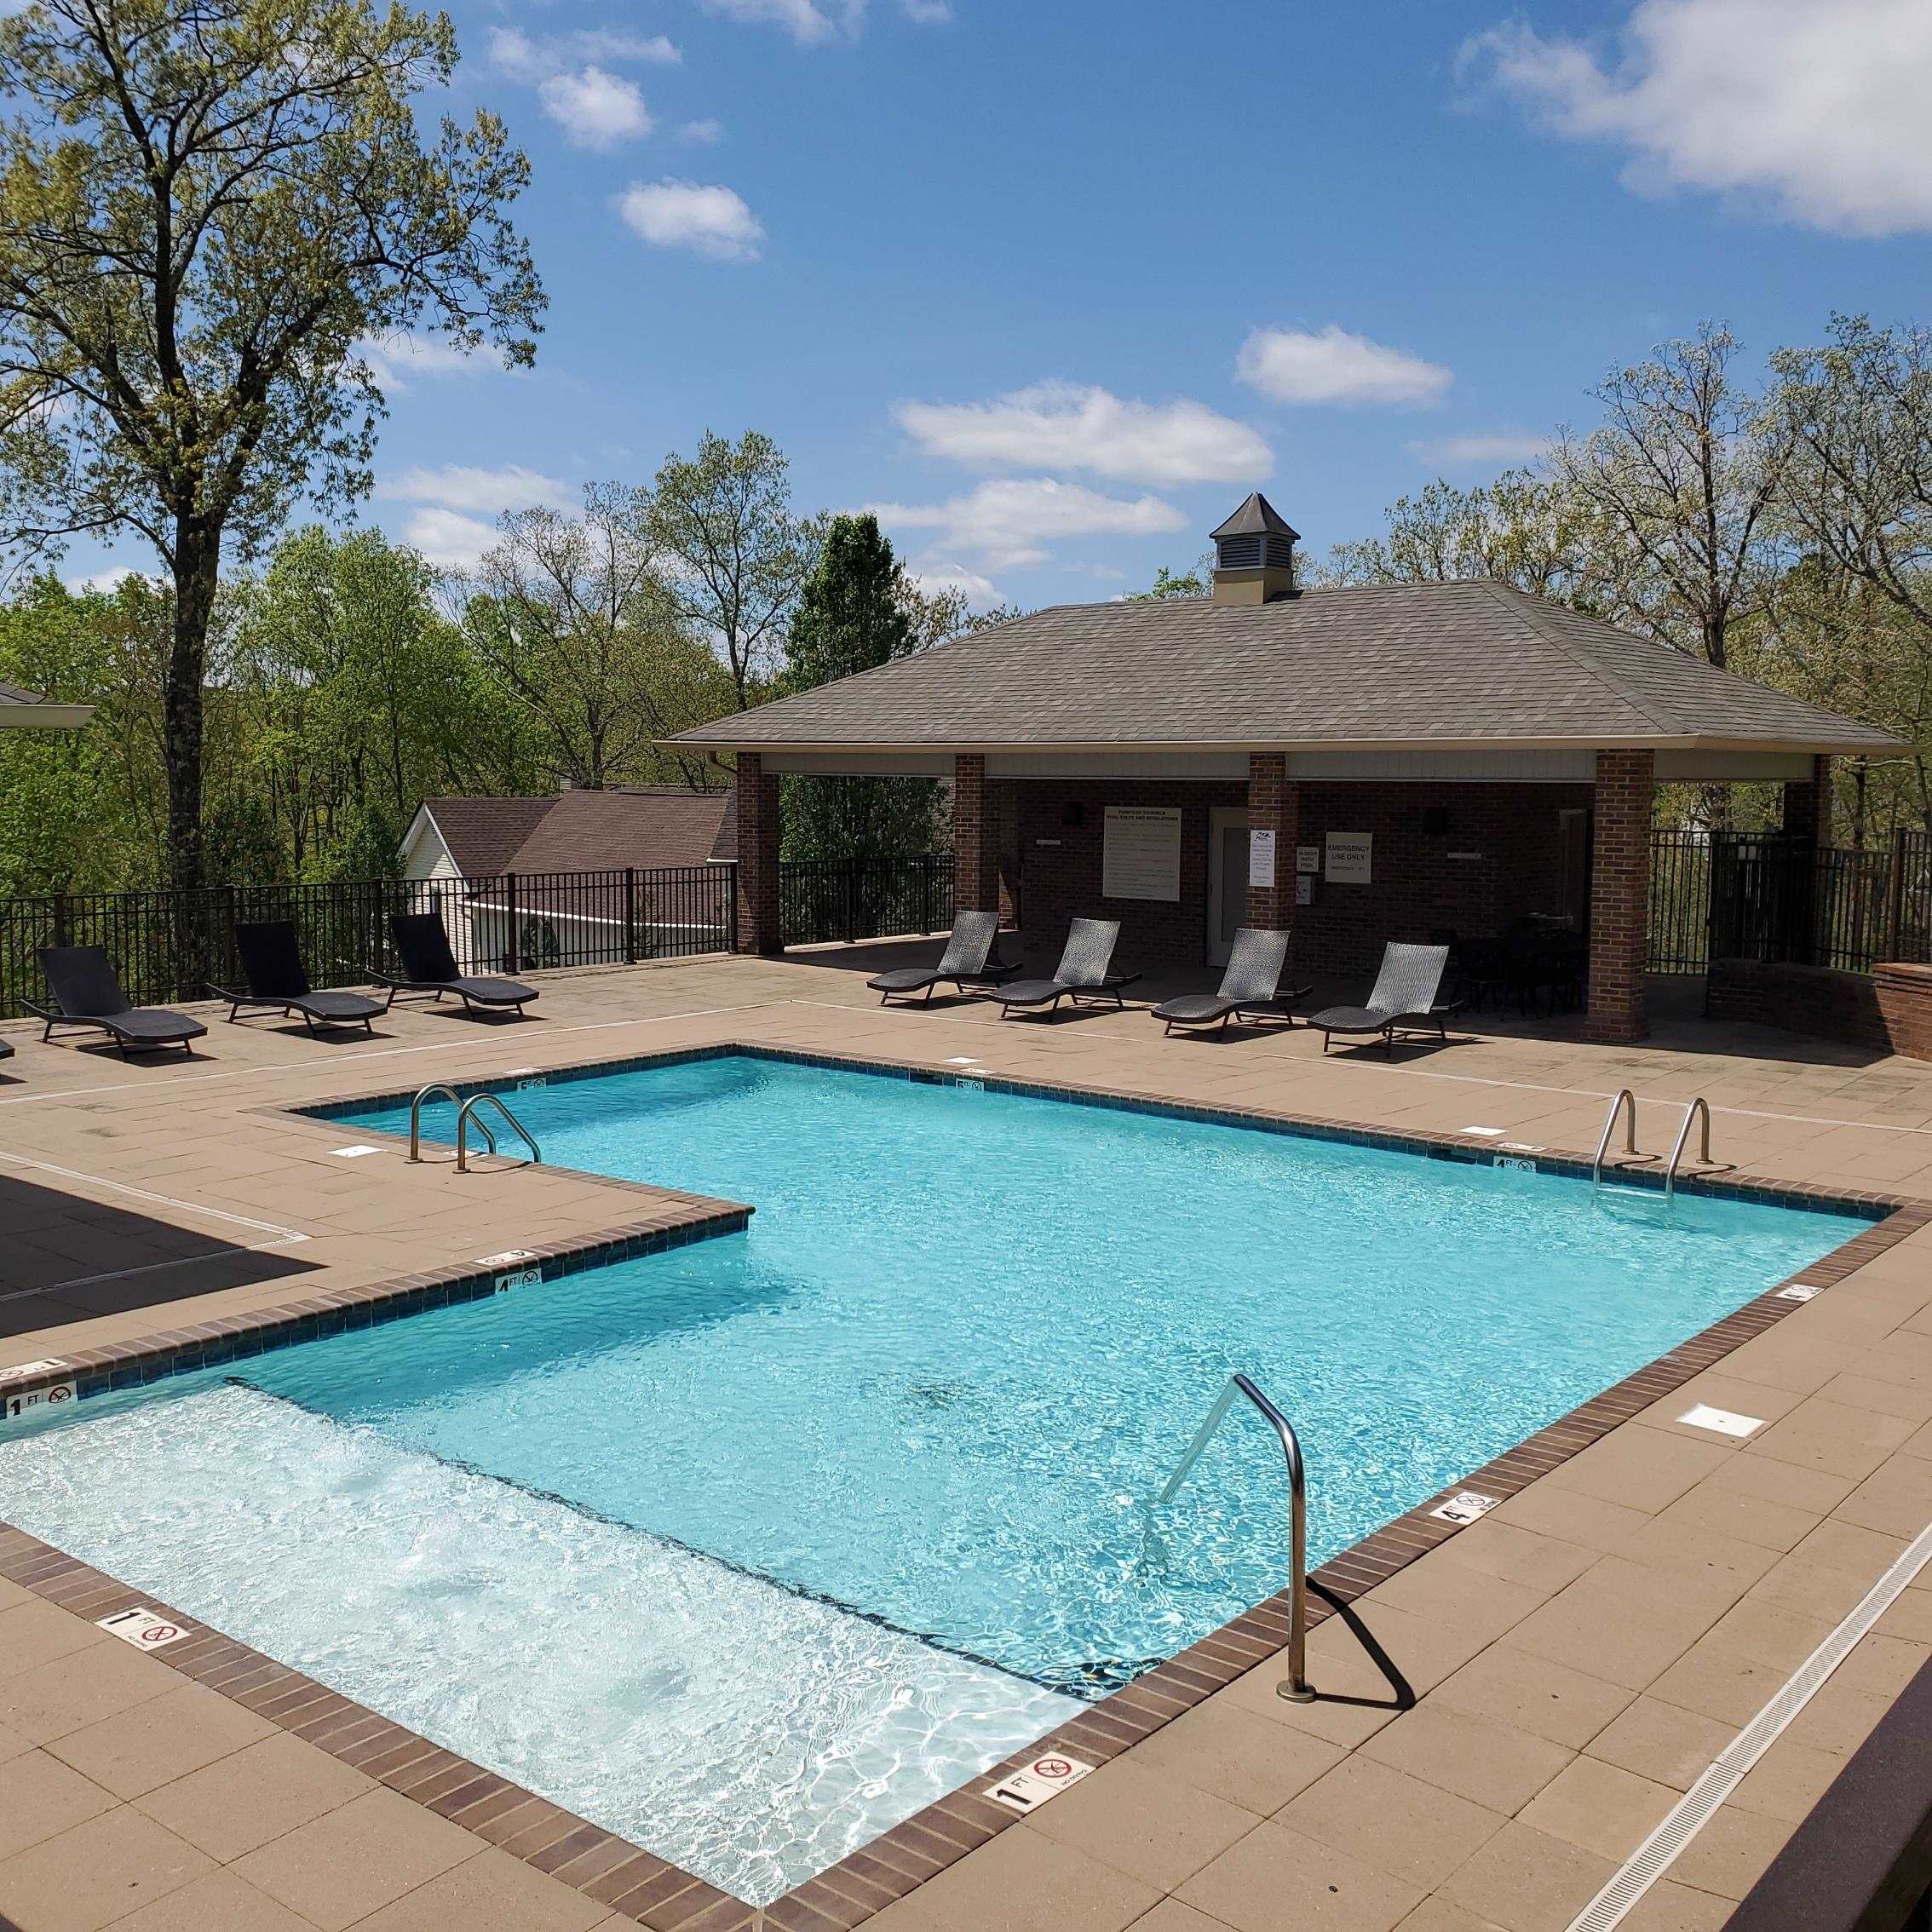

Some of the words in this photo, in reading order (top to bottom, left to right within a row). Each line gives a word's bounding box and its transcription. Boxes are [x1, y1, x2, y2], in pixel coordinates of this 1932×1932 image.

[509, 1277, 517, 1285] FT
[10, 1399, 20, 1416] 1
[28, 1394, 39, 1405] FT
[1441, 1510, 1470, 1520] 4
[106, 1612, 142, 1625] 1
[1011, 1777, 1030, 1788] FT
[996, 1788, 1033, 1806] 1
